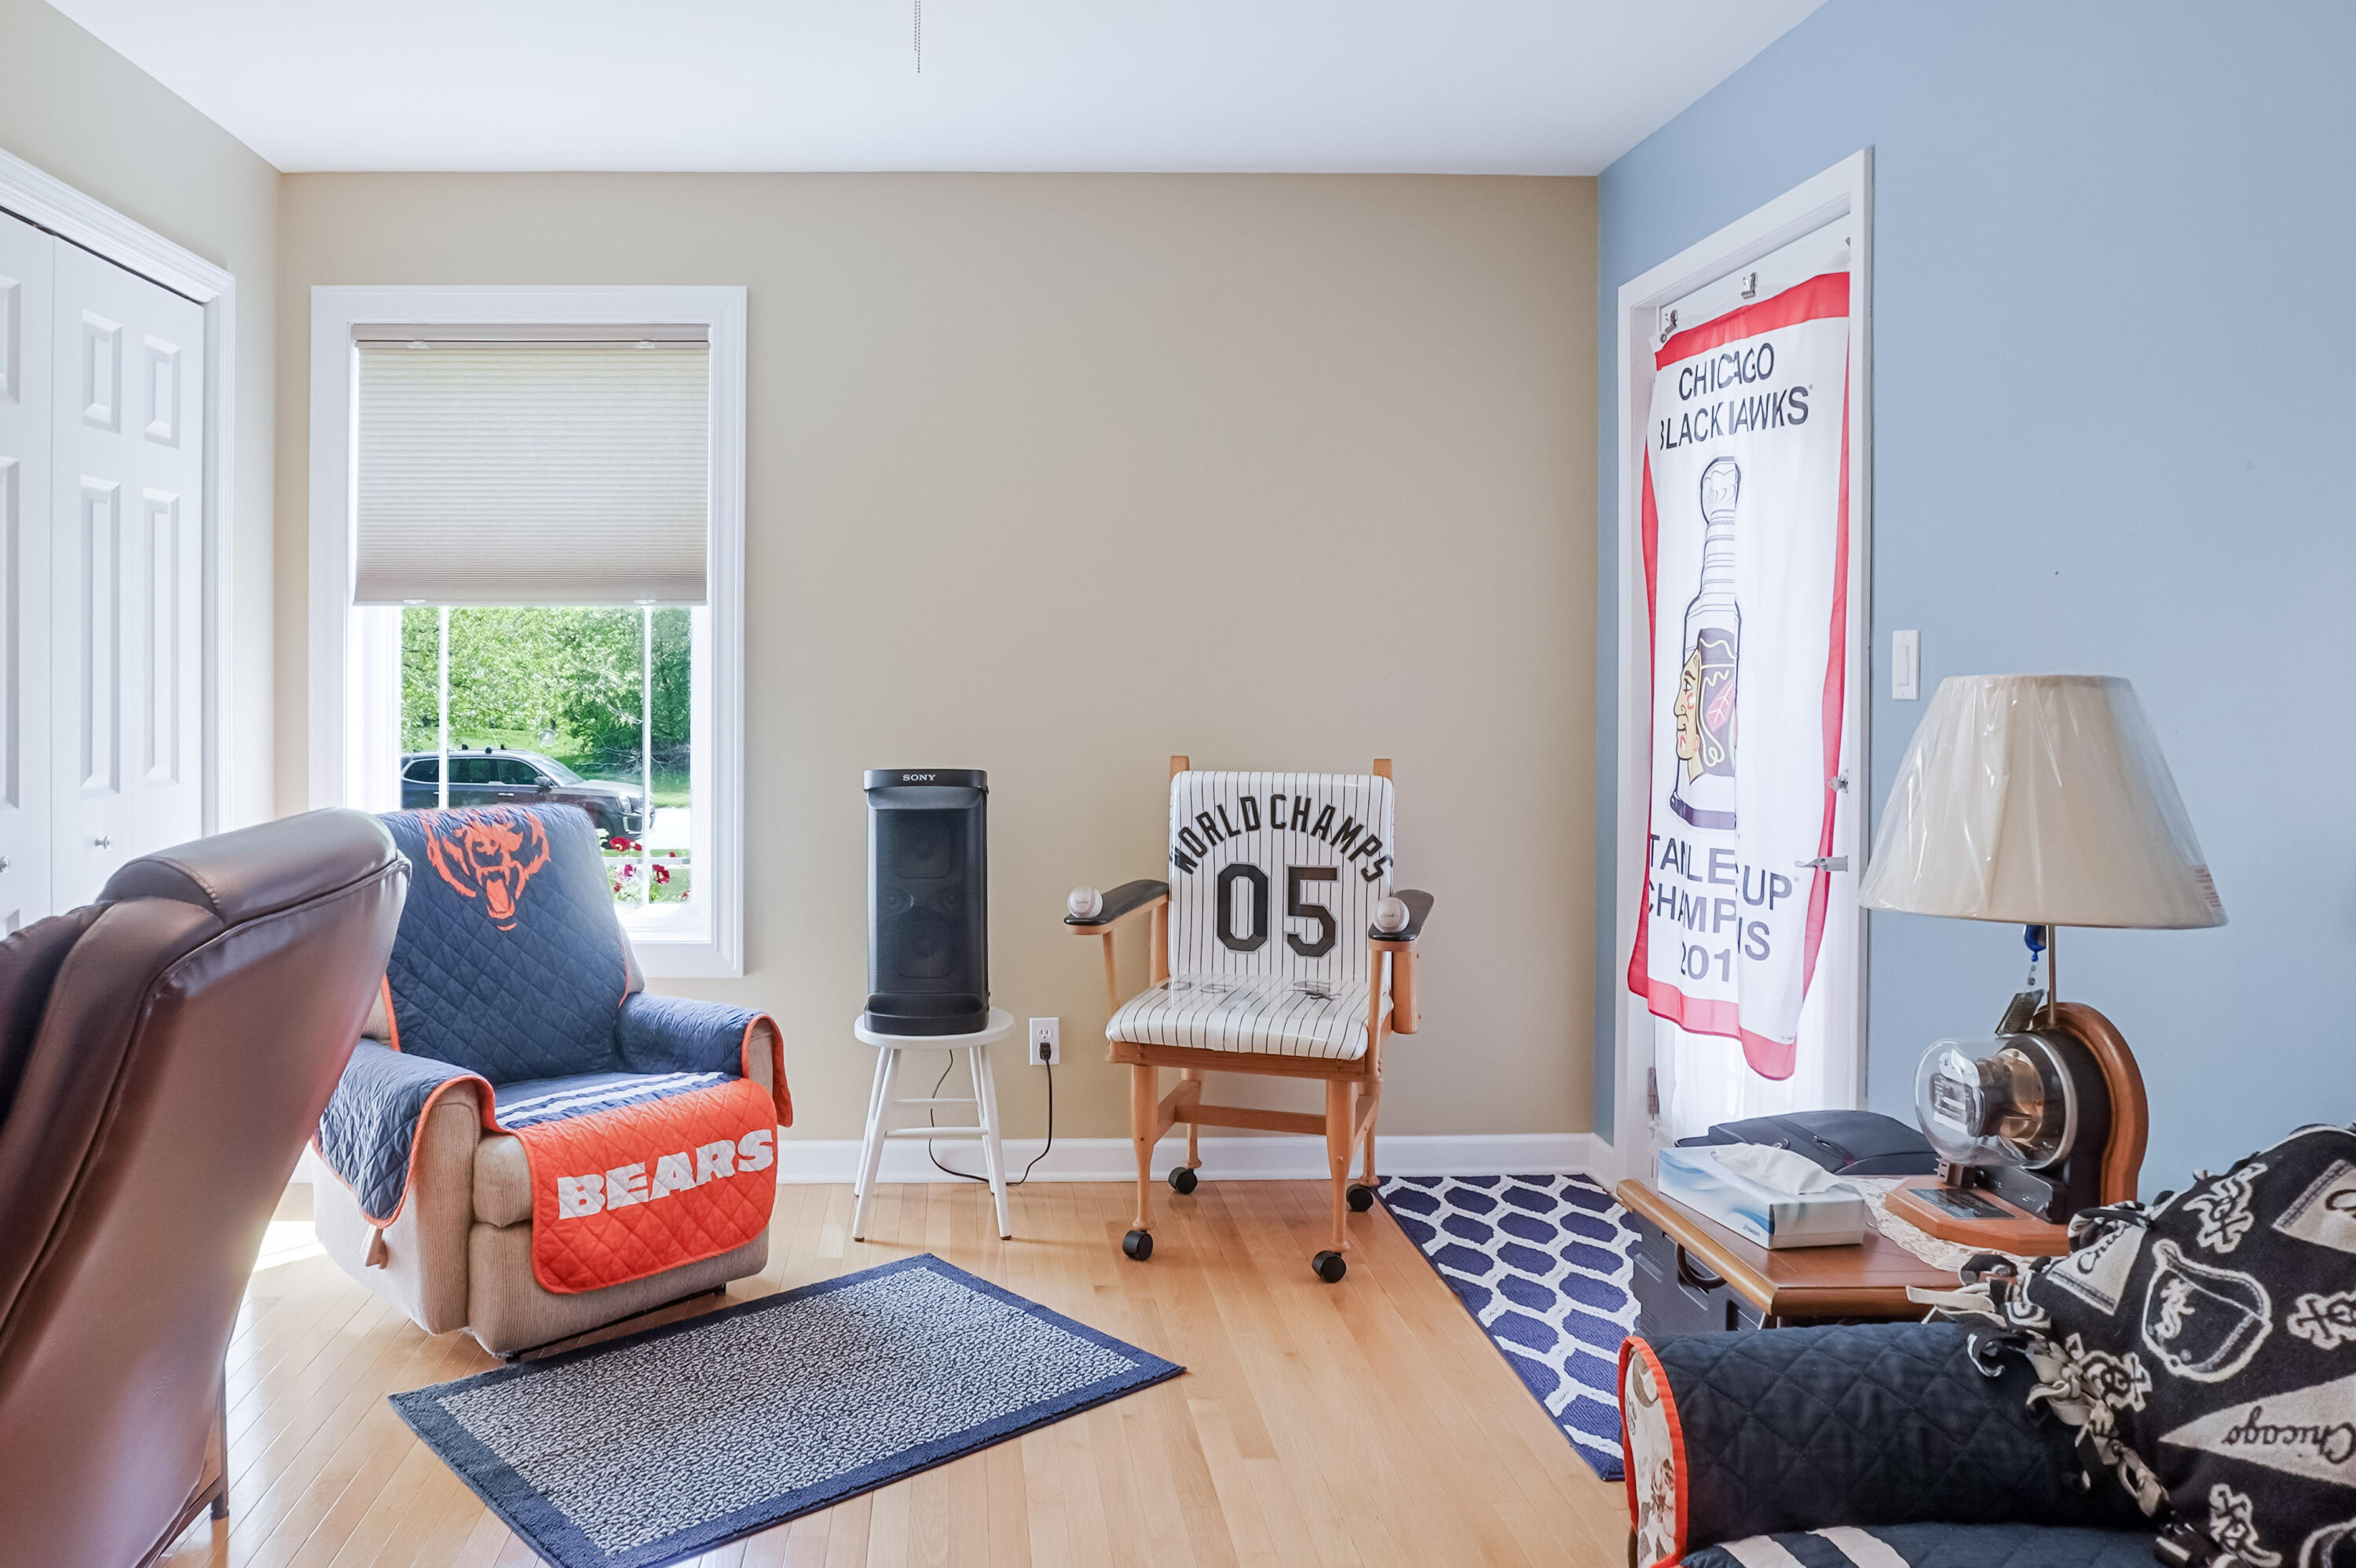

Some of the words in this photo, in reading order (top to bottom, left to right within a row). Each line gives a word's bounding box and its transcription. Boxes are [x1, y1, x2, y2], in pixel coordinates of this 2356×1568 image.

[1678, 342, 1774, 400] CHICAGO
[1169, 795, 1261, 875] WORLD
[1270, 794, 1394, 883] CHAMPS
[1216, 861, 1340, 959] 05
[1734, 862, 1793, 910] UP
[557, 1128, 774, 1220] BEARS
[2221, 1405, 2355, 1464] Chicago
